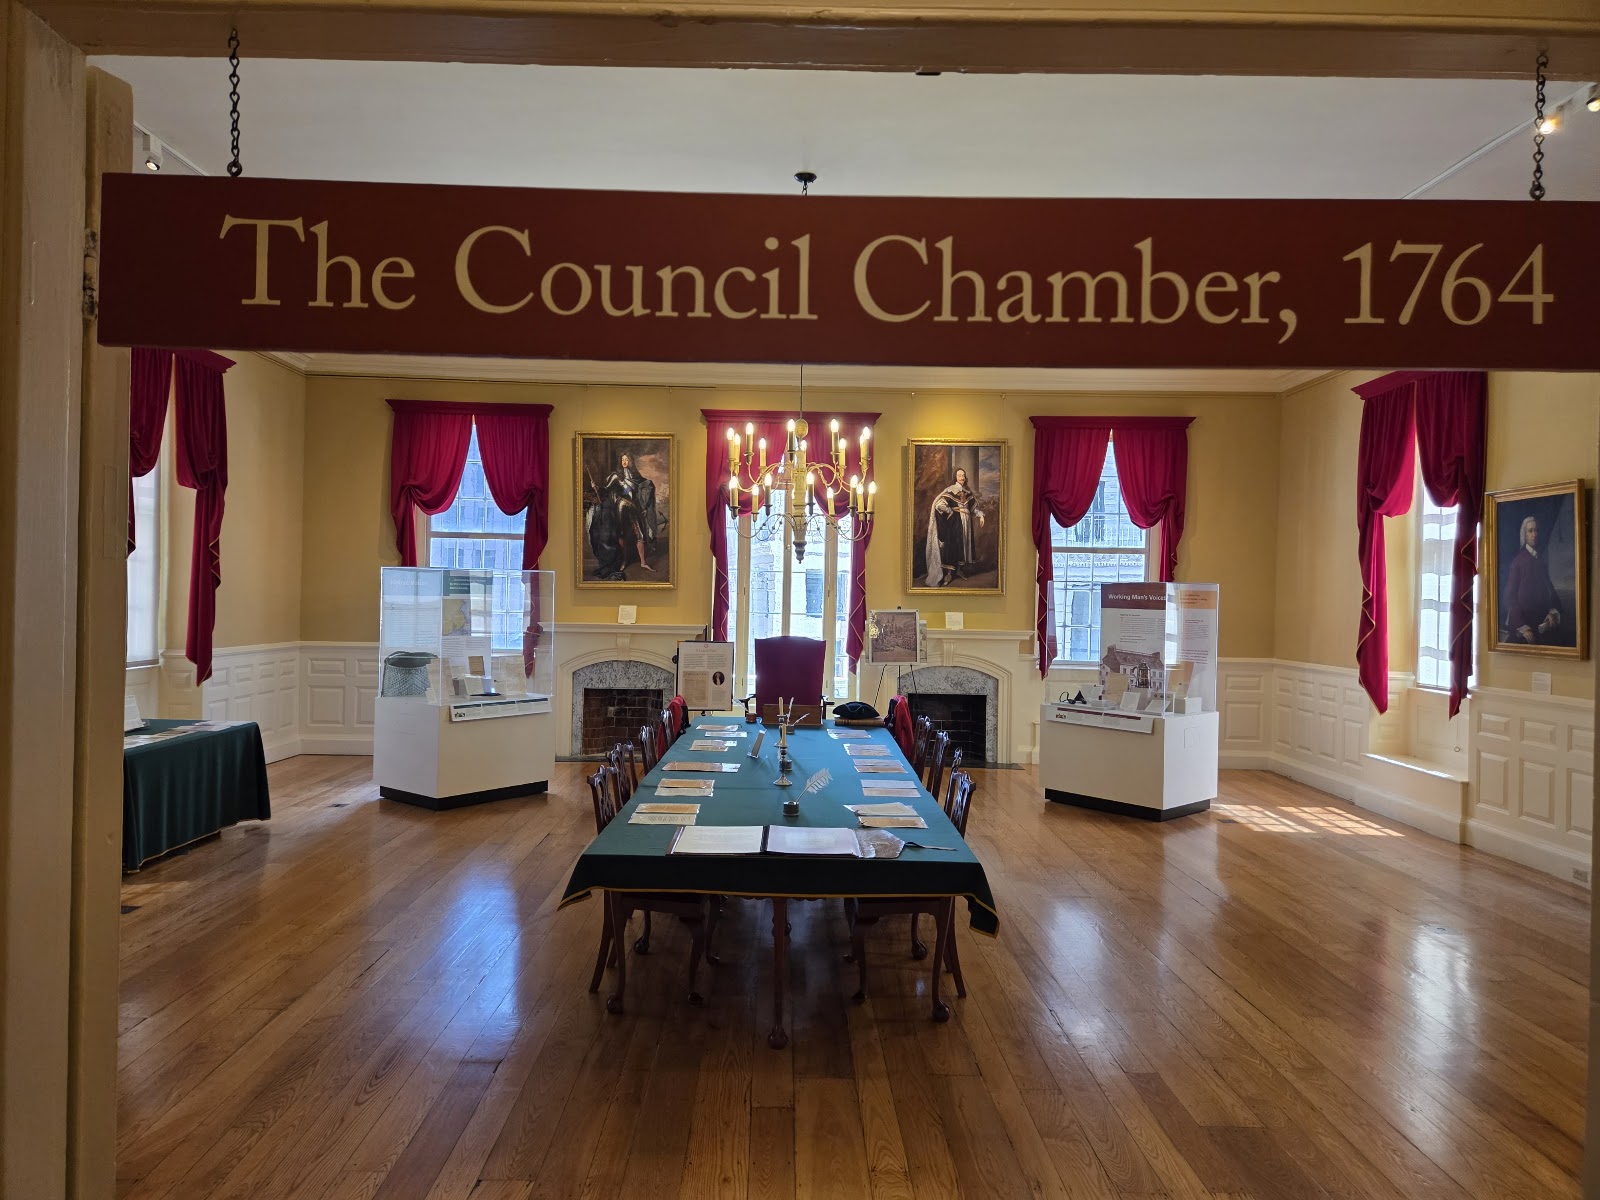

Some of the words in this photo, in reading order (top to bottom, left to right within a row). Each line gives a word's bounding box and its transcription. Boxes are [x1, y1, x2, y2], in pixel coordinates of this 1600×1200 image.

[219, 214, 416, 310] The
[455, 226, 818, 321] Council
[853, 234, 1297, 344] Chamber,
[1343, 241, 1554, 325] 1764
